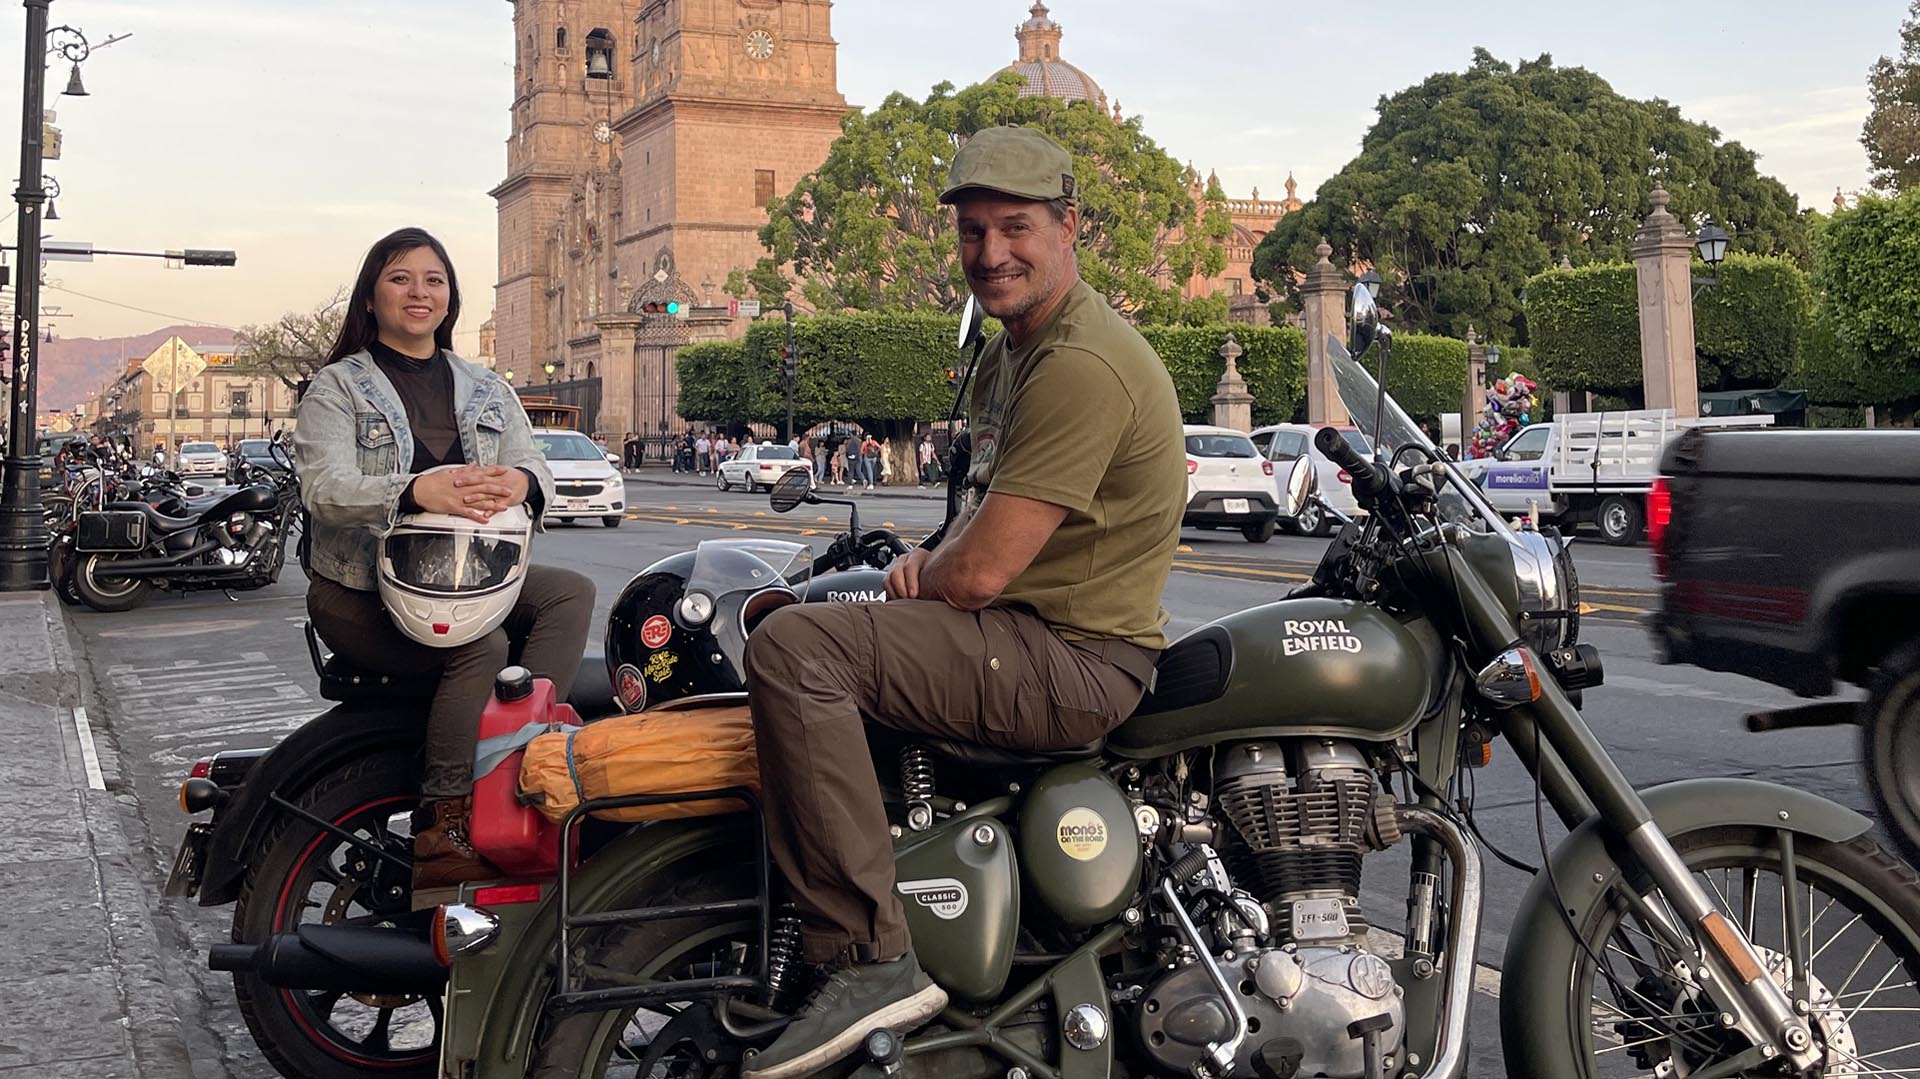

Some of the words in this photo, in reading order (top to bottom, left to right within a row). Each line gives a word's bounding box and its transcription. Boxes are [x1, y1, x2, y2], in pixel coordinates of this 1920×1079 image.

[827, 590, 886, 602] ROYAL
[1283, 620, 1351, 636] ROYAL
[1282, 635, 1362, 656] ENFIELD
[921, 892, 957, 902] CLASSIC
